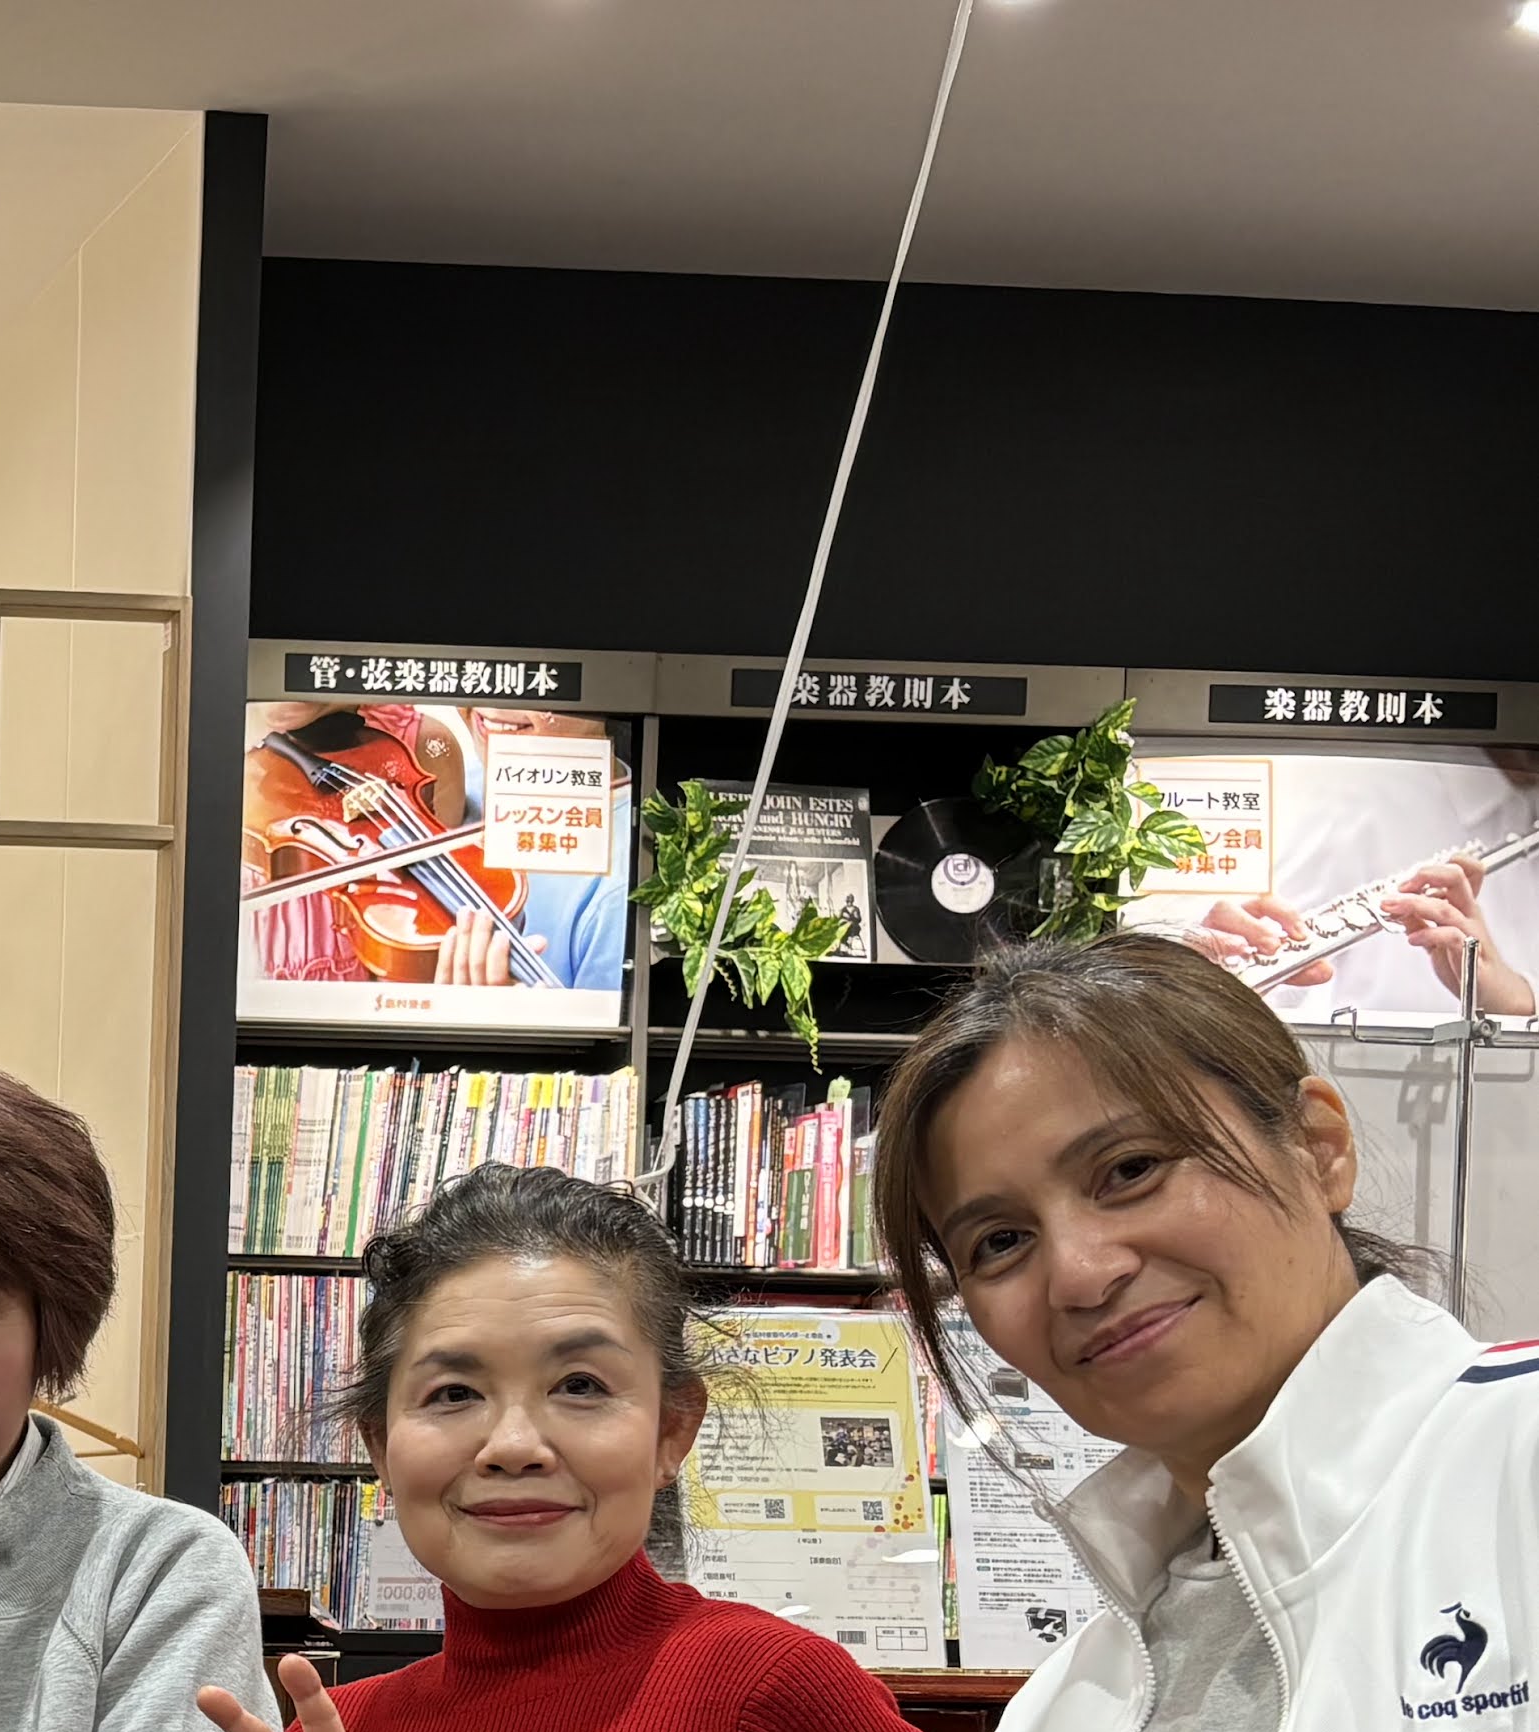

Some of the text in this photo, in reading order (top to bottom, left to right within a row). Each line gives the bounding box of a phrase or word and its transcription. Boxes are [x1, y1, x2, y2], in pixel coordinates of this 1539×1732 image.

[309, 655, 559, 697] 管・弦楽器教則本
[791, 672, 972, 711] 楽器教則本
[1263, 688, 1444, 726] 楽器教則本
[495, 764, 603, 788] バイオリン教室
[763, 793, 803, 811] JOHN
[809, 796, 854, 813] ESTES
[1160, 791, 1261, 811] ルート教室
[494, 803, 603, 829] レッスン会員
[759, 811, 784, 825] and
[791, 811, 854, 829] HUNGRY
[516, 830, 579, 855] 募集中
[1417, 1699, 1458, 1720] coq
[1461, 1680, 1530, 1715] sportif
